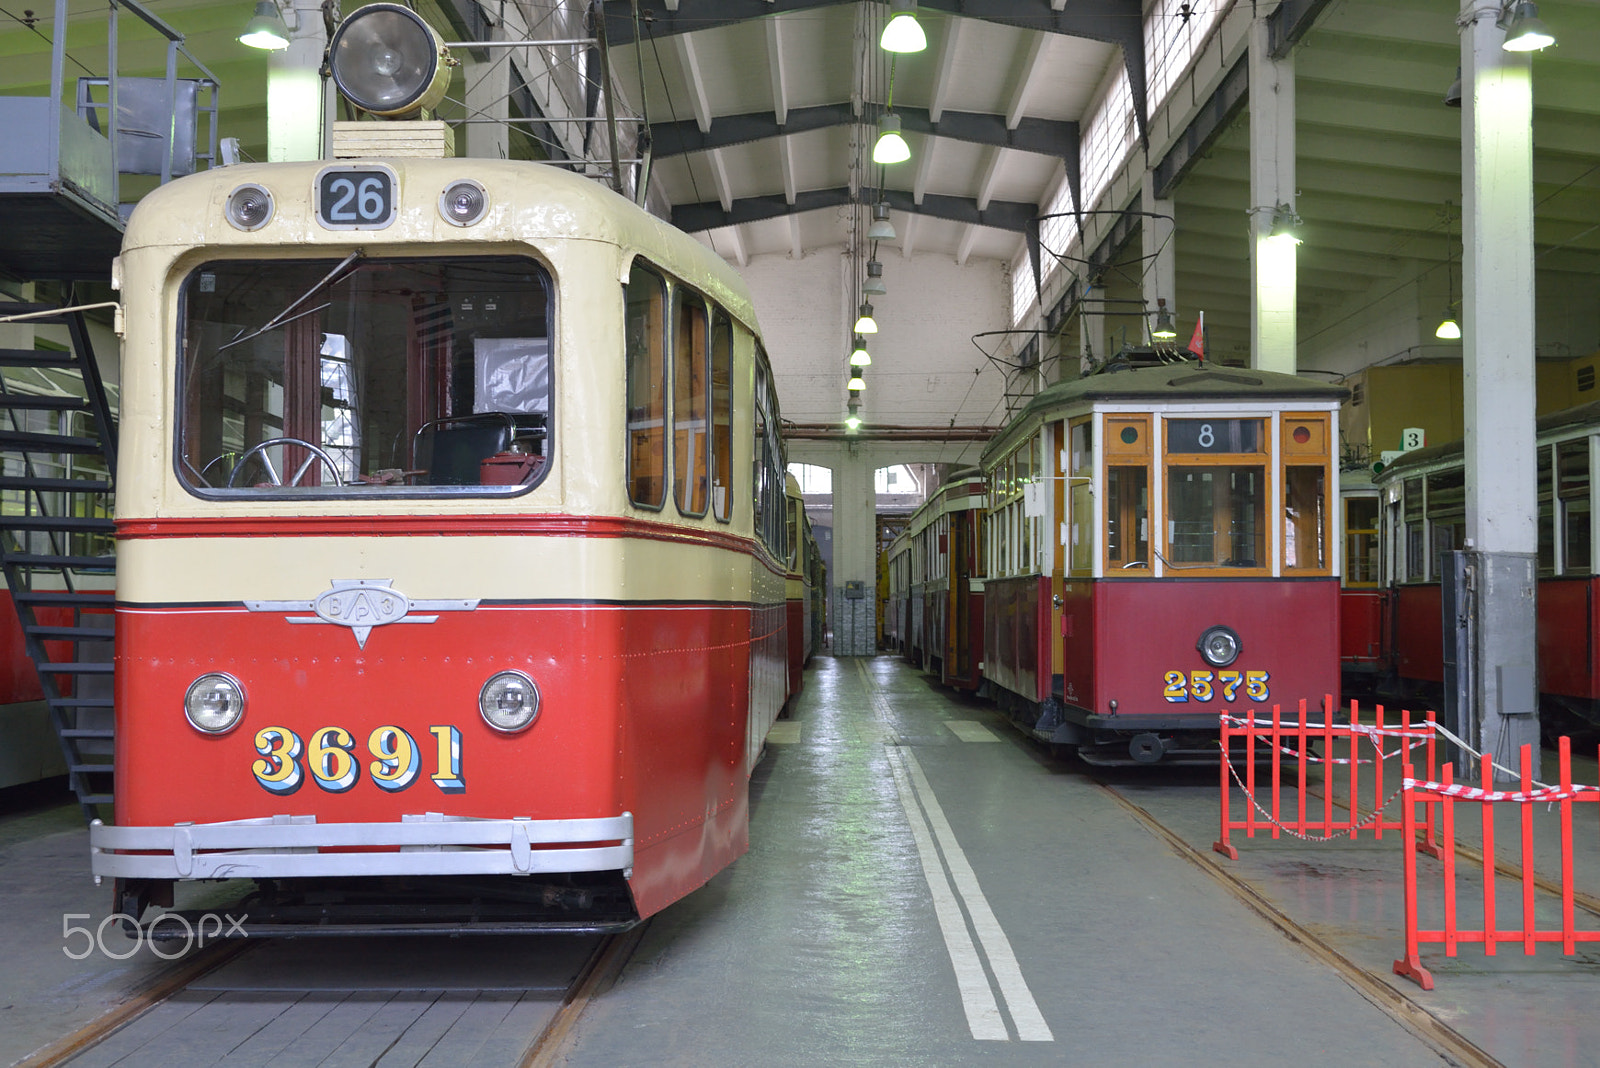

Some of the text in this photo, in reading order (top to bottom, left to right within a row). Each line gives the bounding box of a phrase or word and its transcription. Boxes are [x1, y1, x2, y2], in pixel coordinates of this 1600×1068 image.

[329, 177, 384, 221] 26
[1198, 423, 1215, 448] 8
[1408, 432, 1419, 448] 3
[1163, 670, 1271, 703] 2575
[251, 725, 467, 796] 3691
